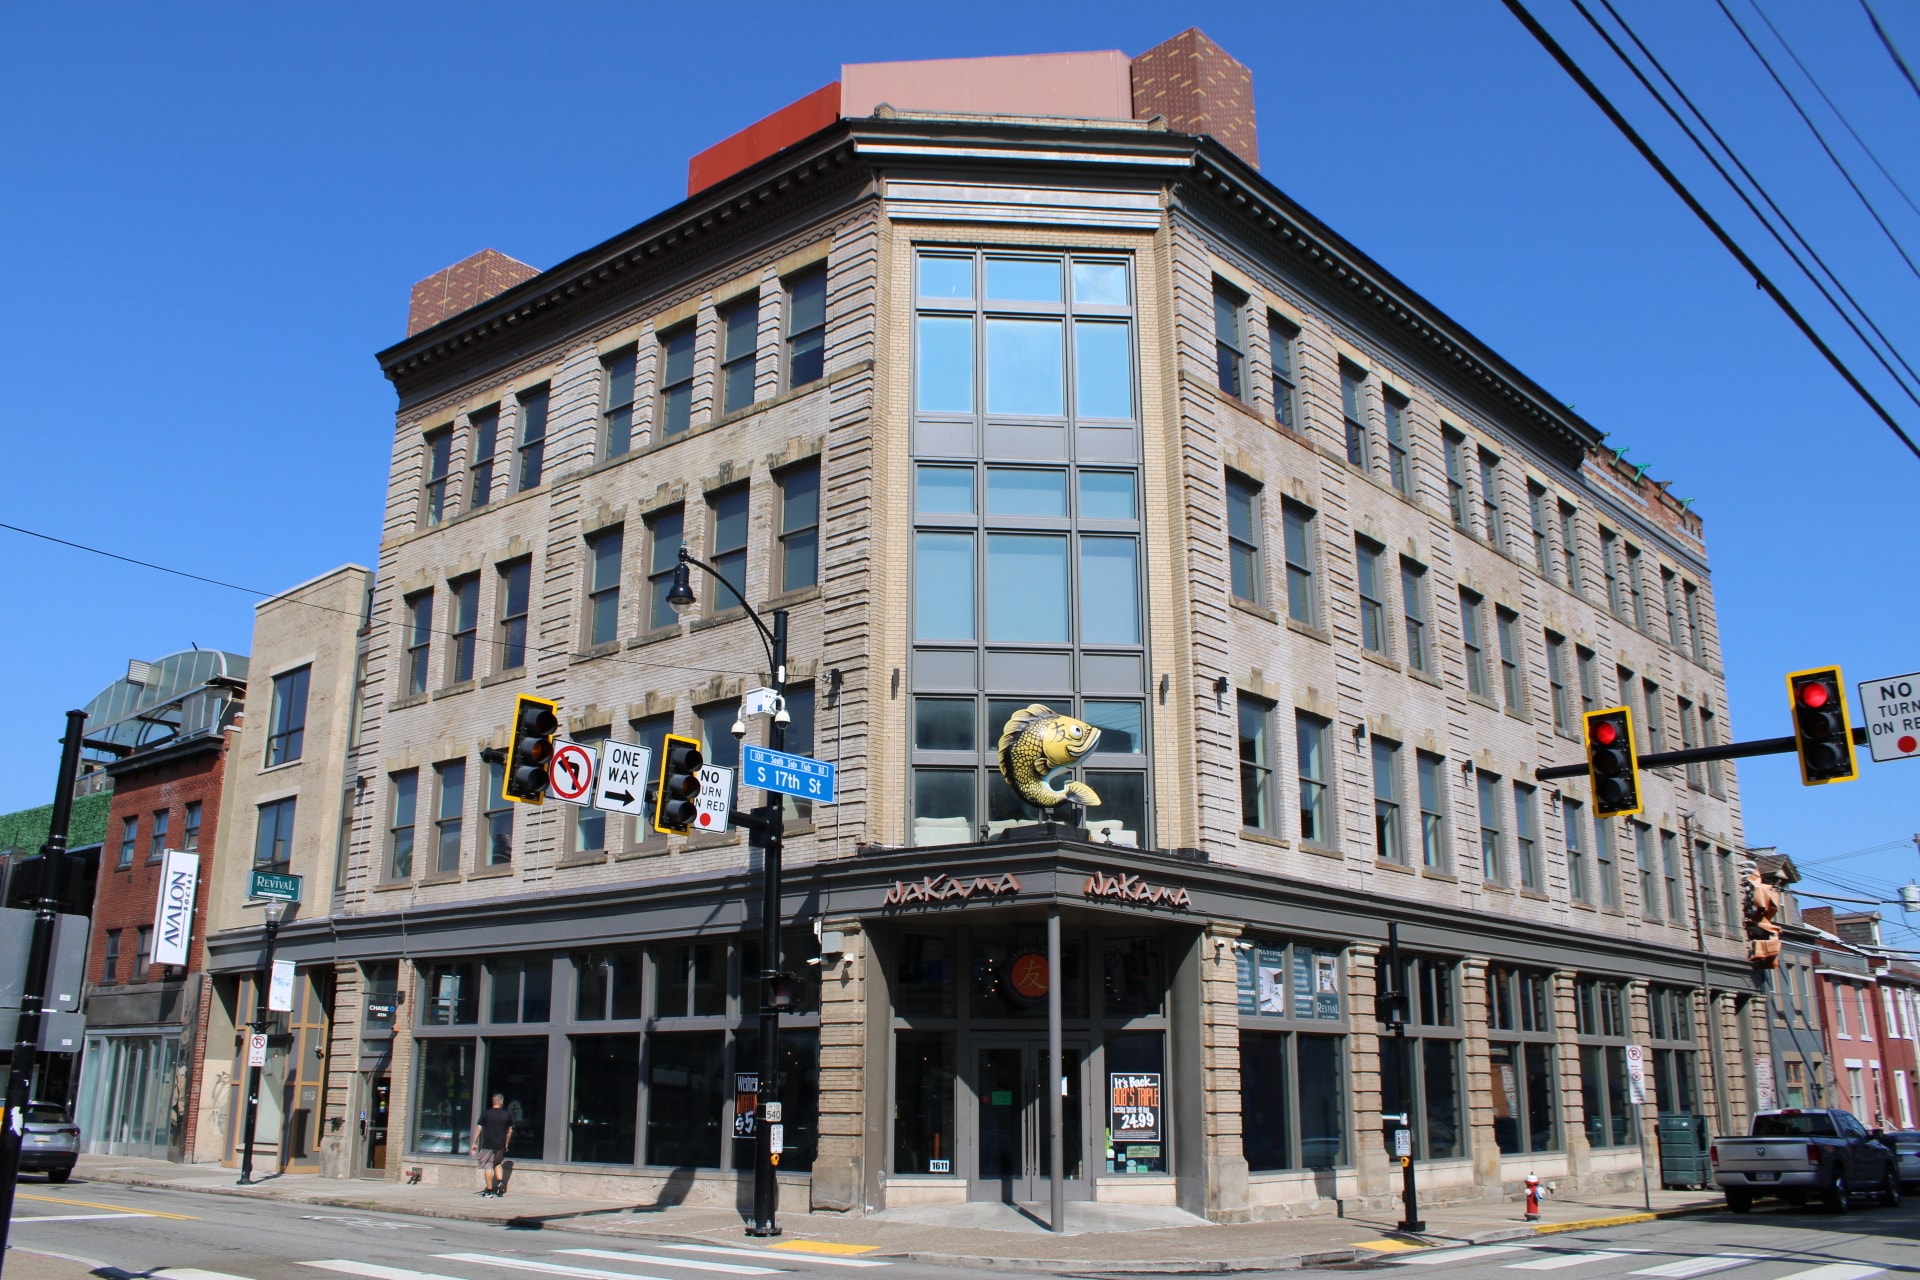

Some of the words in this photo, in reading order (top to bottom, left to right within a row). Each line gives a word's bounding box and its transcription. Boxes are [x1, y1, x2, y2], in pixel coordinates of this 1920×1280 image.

[1880, 682, 1912, 701] NO
[1877, 699, 1920, 717] TURN
[1872, 721, 1894, 735] ON
[1903, 716, 1920, 731] RE
[612, 748, 640, 767] ONE
[754, 752, 764, 761] 100
[771, 755, 784, 766] South
[788, 759, 797, 769] Side
[801, 761, 812, 772] Flats
[818, 766, 825, 775] 80
[608, 766, 639, 785] WAY
[701, 769, 720, 784] NO
[757, 766, 766, 783] S
[775, 770, 800, 790] 17th
[808, 777, 822, 794] St
[701, 787, 721, 798] URN
[707, 801, 725, 812] RED
[183, 873, 193, 911] SOCIAL
[256, 875, 295, 891] REVIVAL
[883, 872, 1021, 904] NAKAMA
[1084, 870, 1192, 906] NAKAMA
[164, 870, 187, 948] AVALON
[1018, 960, 1047, 989] 友
[369, 1004, 389, 1012] CHASE
[1114, 1077, 1128, 1088] It's
[1114, 1088, 1134, 1106] BOB'S
[1138, 1088, 1158, 1106] TRIPLE
[767, 1111, 780, 1119] 540
[1121, 1112, 1154, 1129] 24.99
[932, 1161, 948, 1170] 1611
